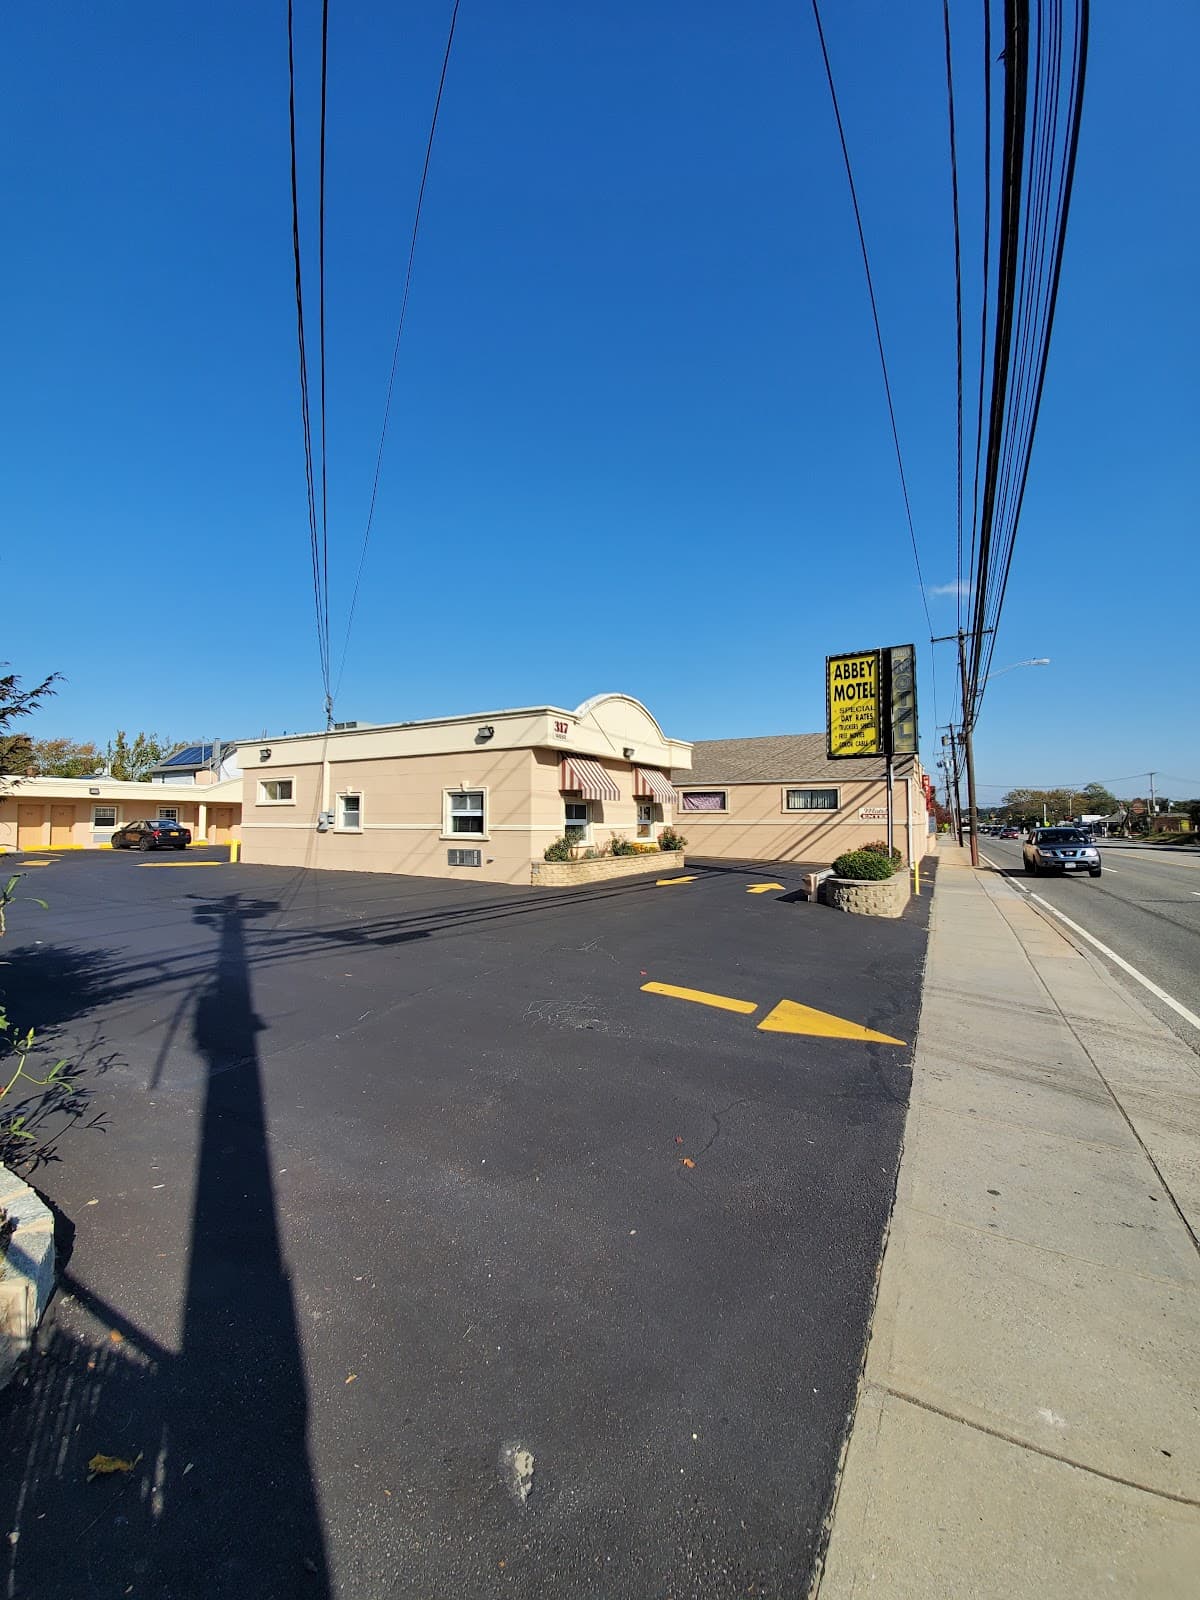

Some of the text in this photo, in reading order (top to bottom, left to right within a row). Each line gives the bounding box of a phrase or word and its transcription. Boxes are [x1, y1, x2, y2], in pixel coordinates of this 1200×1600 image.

[834, 660, 875, 680] ABBEY
[834, 682, 876, 702] MOTEL
[839, 705, 876, 714] SPECIAL
[841, 713, 873, 722] DAY RATES
[554, 720, 569, 734] 317
